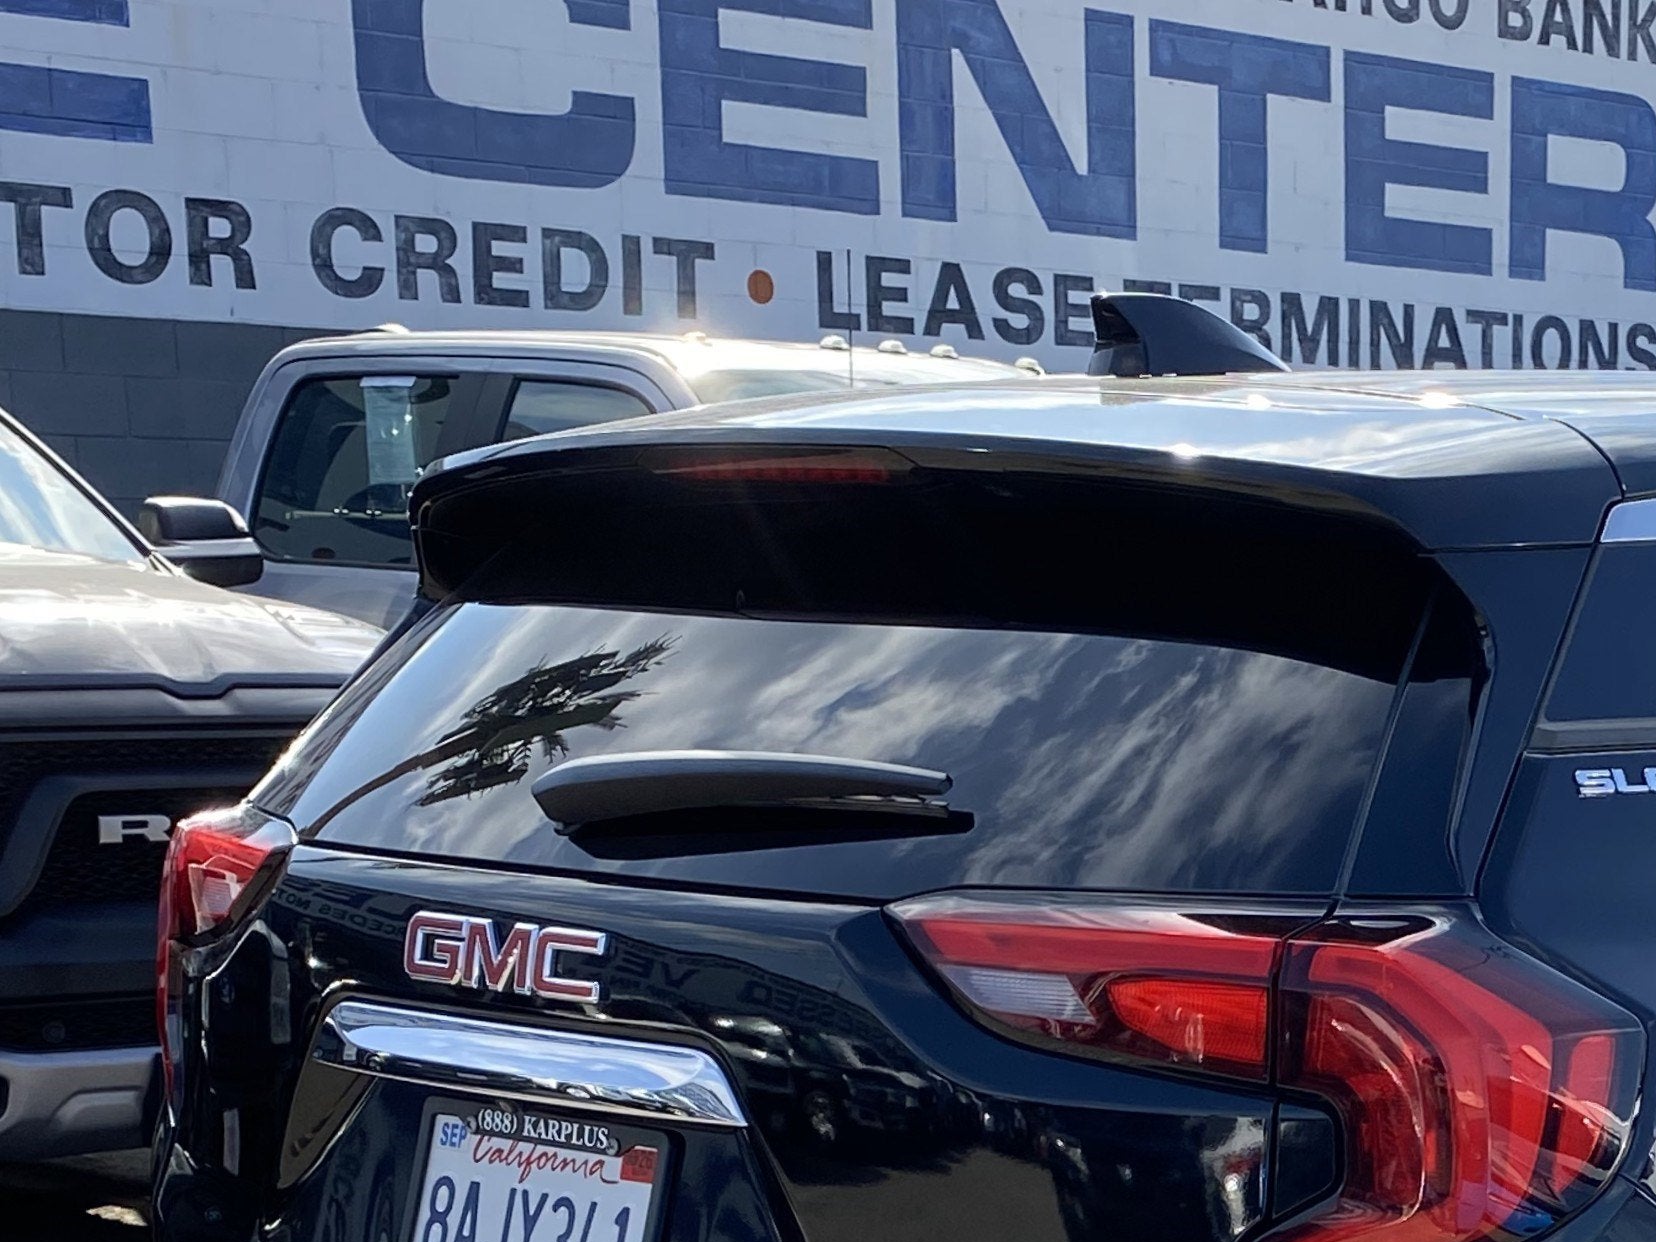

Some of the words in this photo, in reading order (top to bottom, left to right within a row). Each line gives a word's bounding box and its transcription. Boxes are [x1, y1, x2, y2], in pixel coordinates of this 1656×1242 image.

[0, 181, 256, 290] TOR
[309, 206, 716, 320] CREDIT
[815, 249, 1094, 347] LEASE
[404, 910, 606, 1003] GMC
[439, 1121, 468, 1149] SEP
[477, 1108, 518, 1135] (888)
[522, 1114, 609, 1149] KARPLUS
[472, 1134, 619, 1184] California
